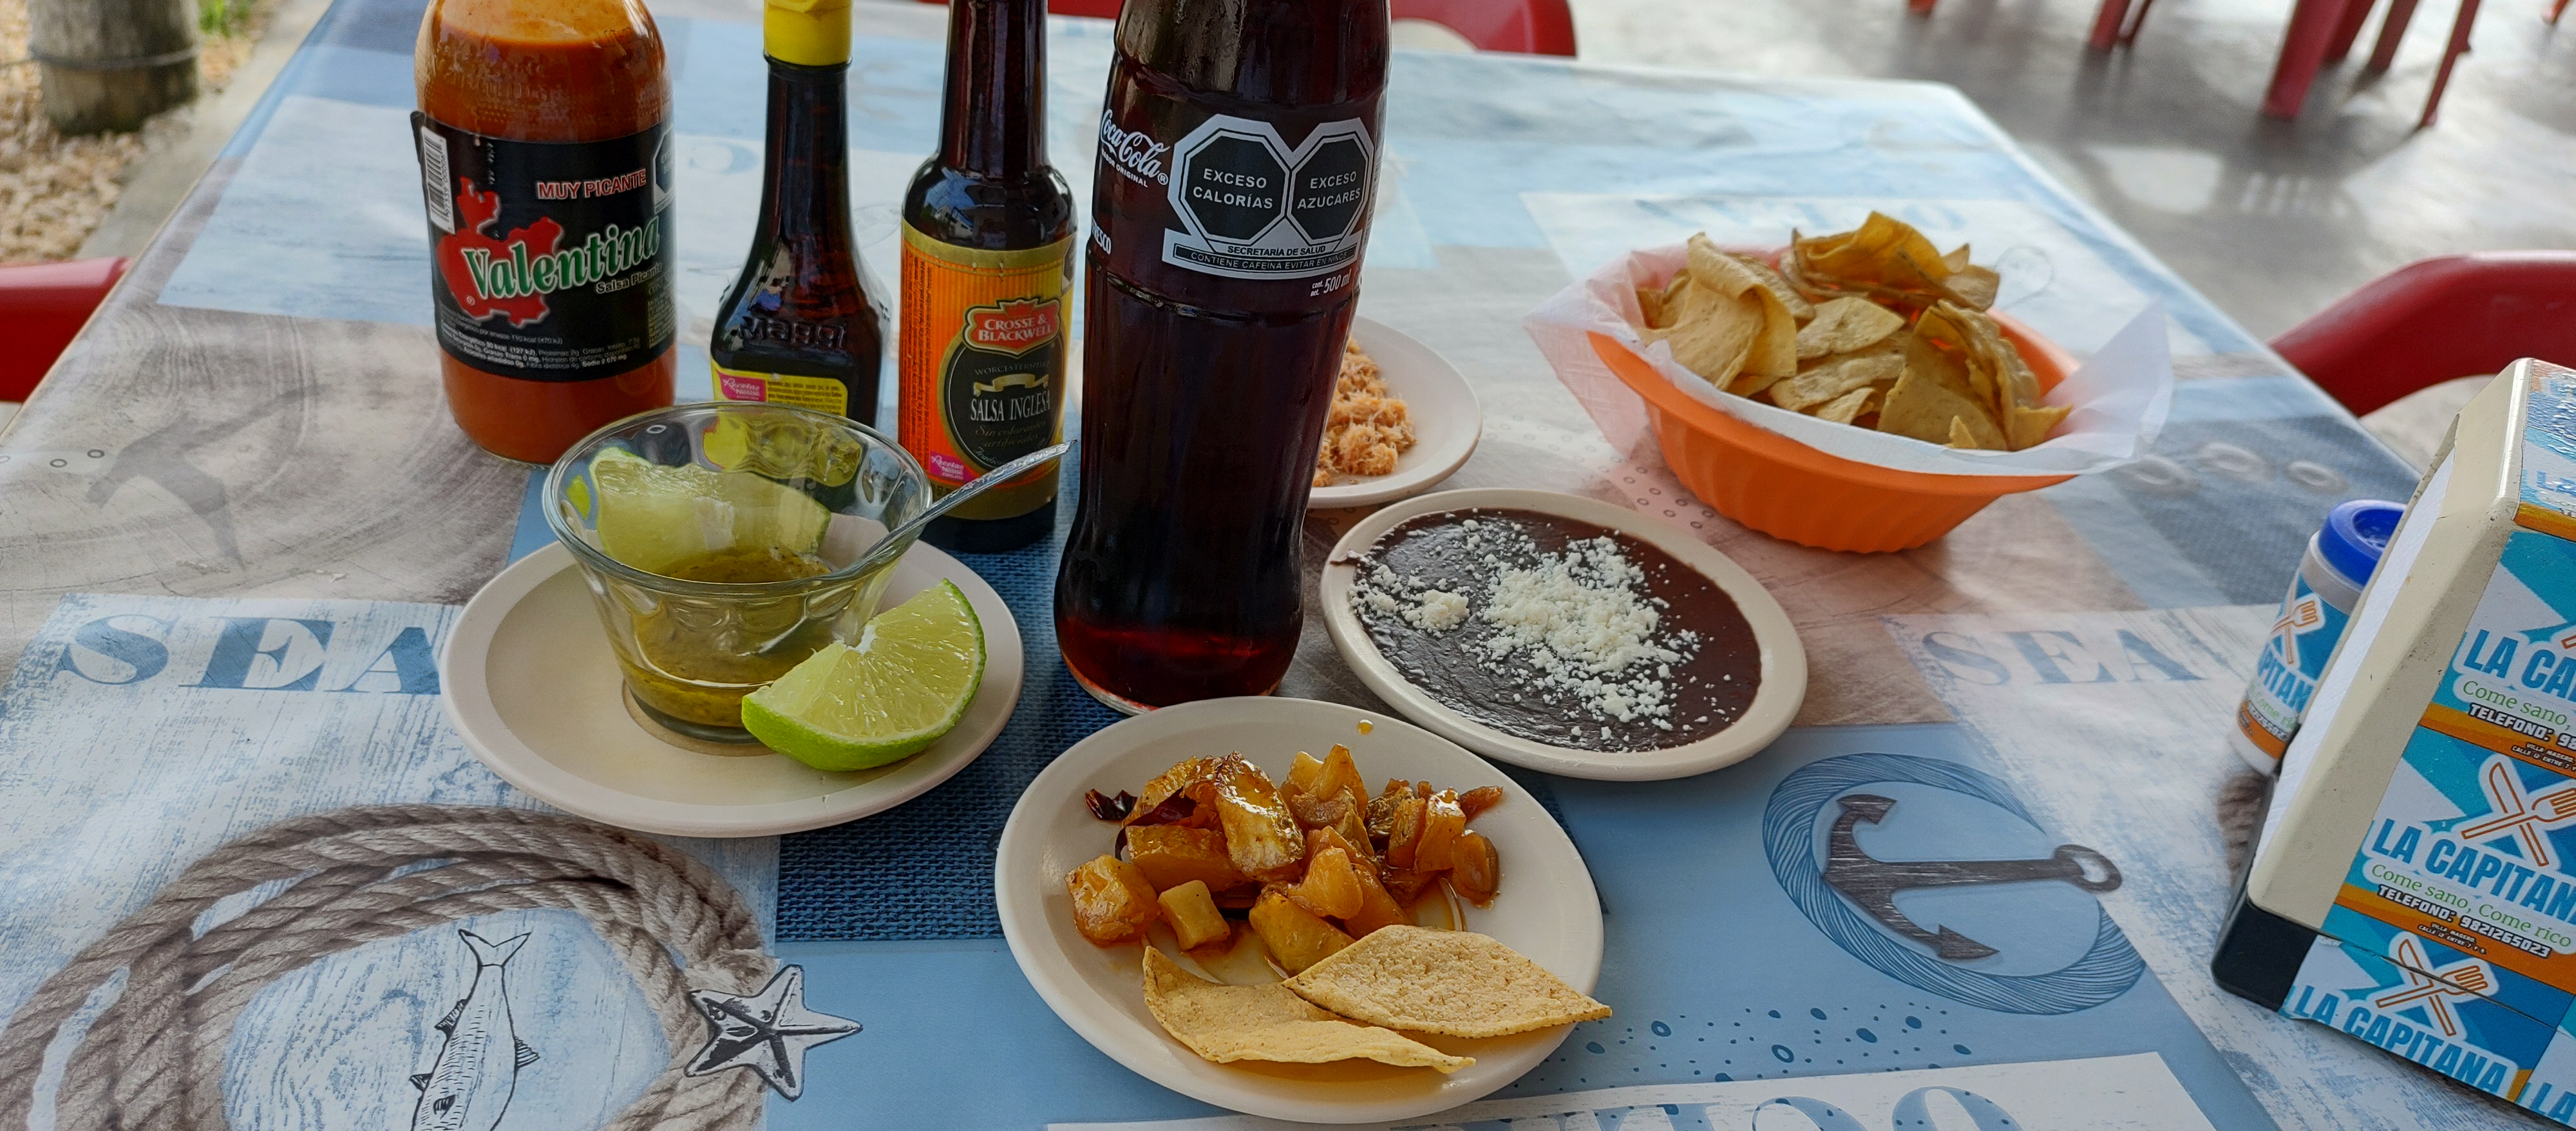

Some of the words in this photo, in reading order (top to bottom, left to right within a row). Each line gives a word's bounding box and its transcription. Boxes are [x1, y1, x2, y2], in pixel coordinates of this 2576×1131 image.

[537, 182, 582, 200] MUY
[583, 168, 647, 198] PICANTE
[1116, 164, 1148, 188] ORIGINAL
[1203, 167, 1267, 189] EXCESO
[1310, 171, 1357, 189] EXCESO
[1193, 186, 1273, 209] CALORÍAS
[1297, 187, 1361, 209] AZÚCARES
[461, 216, 660, 299] Valentina
[1191, 252, 1239, 268] CONTIENE
[1284, 260, 1314, 269] EVITAR
[1316, 258, 1327, 267] EN
[1227, 246, 1285, 256] SECRETARÍA
[1286, 248, 1299, 256] DE
[1300, 245, 1326, 256] SALUD
[596, 278, 630, 294] Salsa
[631, 262, 663, 286] Picante
[1323, 275, 1341, 294] 500
[1341, 269, 1352, 287] ml
[978, 324, 1052, 341] BLACKWELL
[984, 317, 1036, 332] CROSSE
[1037, 314, 1047, 325] &
[723, 377, 760, 392] Recetas
[971, 398, 1005, 422] SALSA
[1010, 390, 1051, 421] INGLESA
[53, 614, 442, 696] SEA
[1922, 629, 2211, 685] SEA
[2463, 629, 2519, 680] LA
[2463, 681, 2518, 708] Come
[2519, 702, 2571, 730] sano,
[2468, 703, 2554, 742] TELEFONO:
[2512, 746, 2532, 756] CALLE
[2371, 818, 2423, 864] LA
[2372, 864, 2423, 891] Come
[2425, 885, 2472, 915] sano,
[2479, 904, 2532, 933] Come
[2534, 926, 2571, 947] rico
[2378, 885, 2456, 922] TELEFONO:
[2459, 915, 2552, 958] 9821265023
[2418, 925, 2436, 935] CALLE
[2294, 985, 2340, 1025] LA
[2343, 1006, 2508, 1093] CAPITANA
[2528, 1082, 2576, 1123] LA
